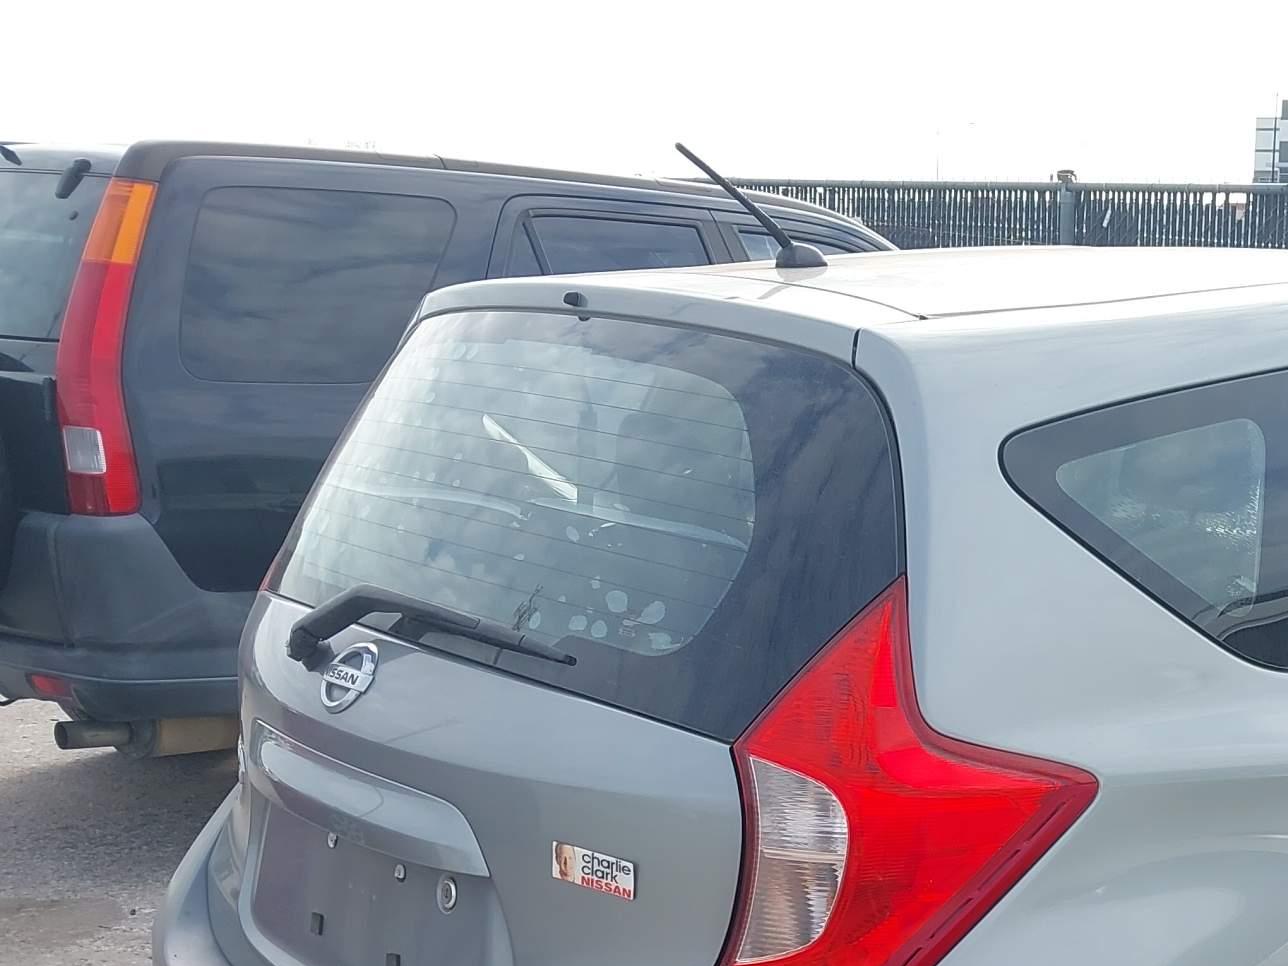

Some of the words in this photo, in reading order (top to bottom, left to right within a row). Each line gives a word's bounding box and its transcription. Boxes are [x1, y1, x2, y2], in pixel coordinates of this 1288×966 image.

[325, 665, 359, 685] SSAN
[581, 852, 631, 875] charlie
[581, 864, 619, 884] clark
[580, 875, 631, 898] NISSAN
